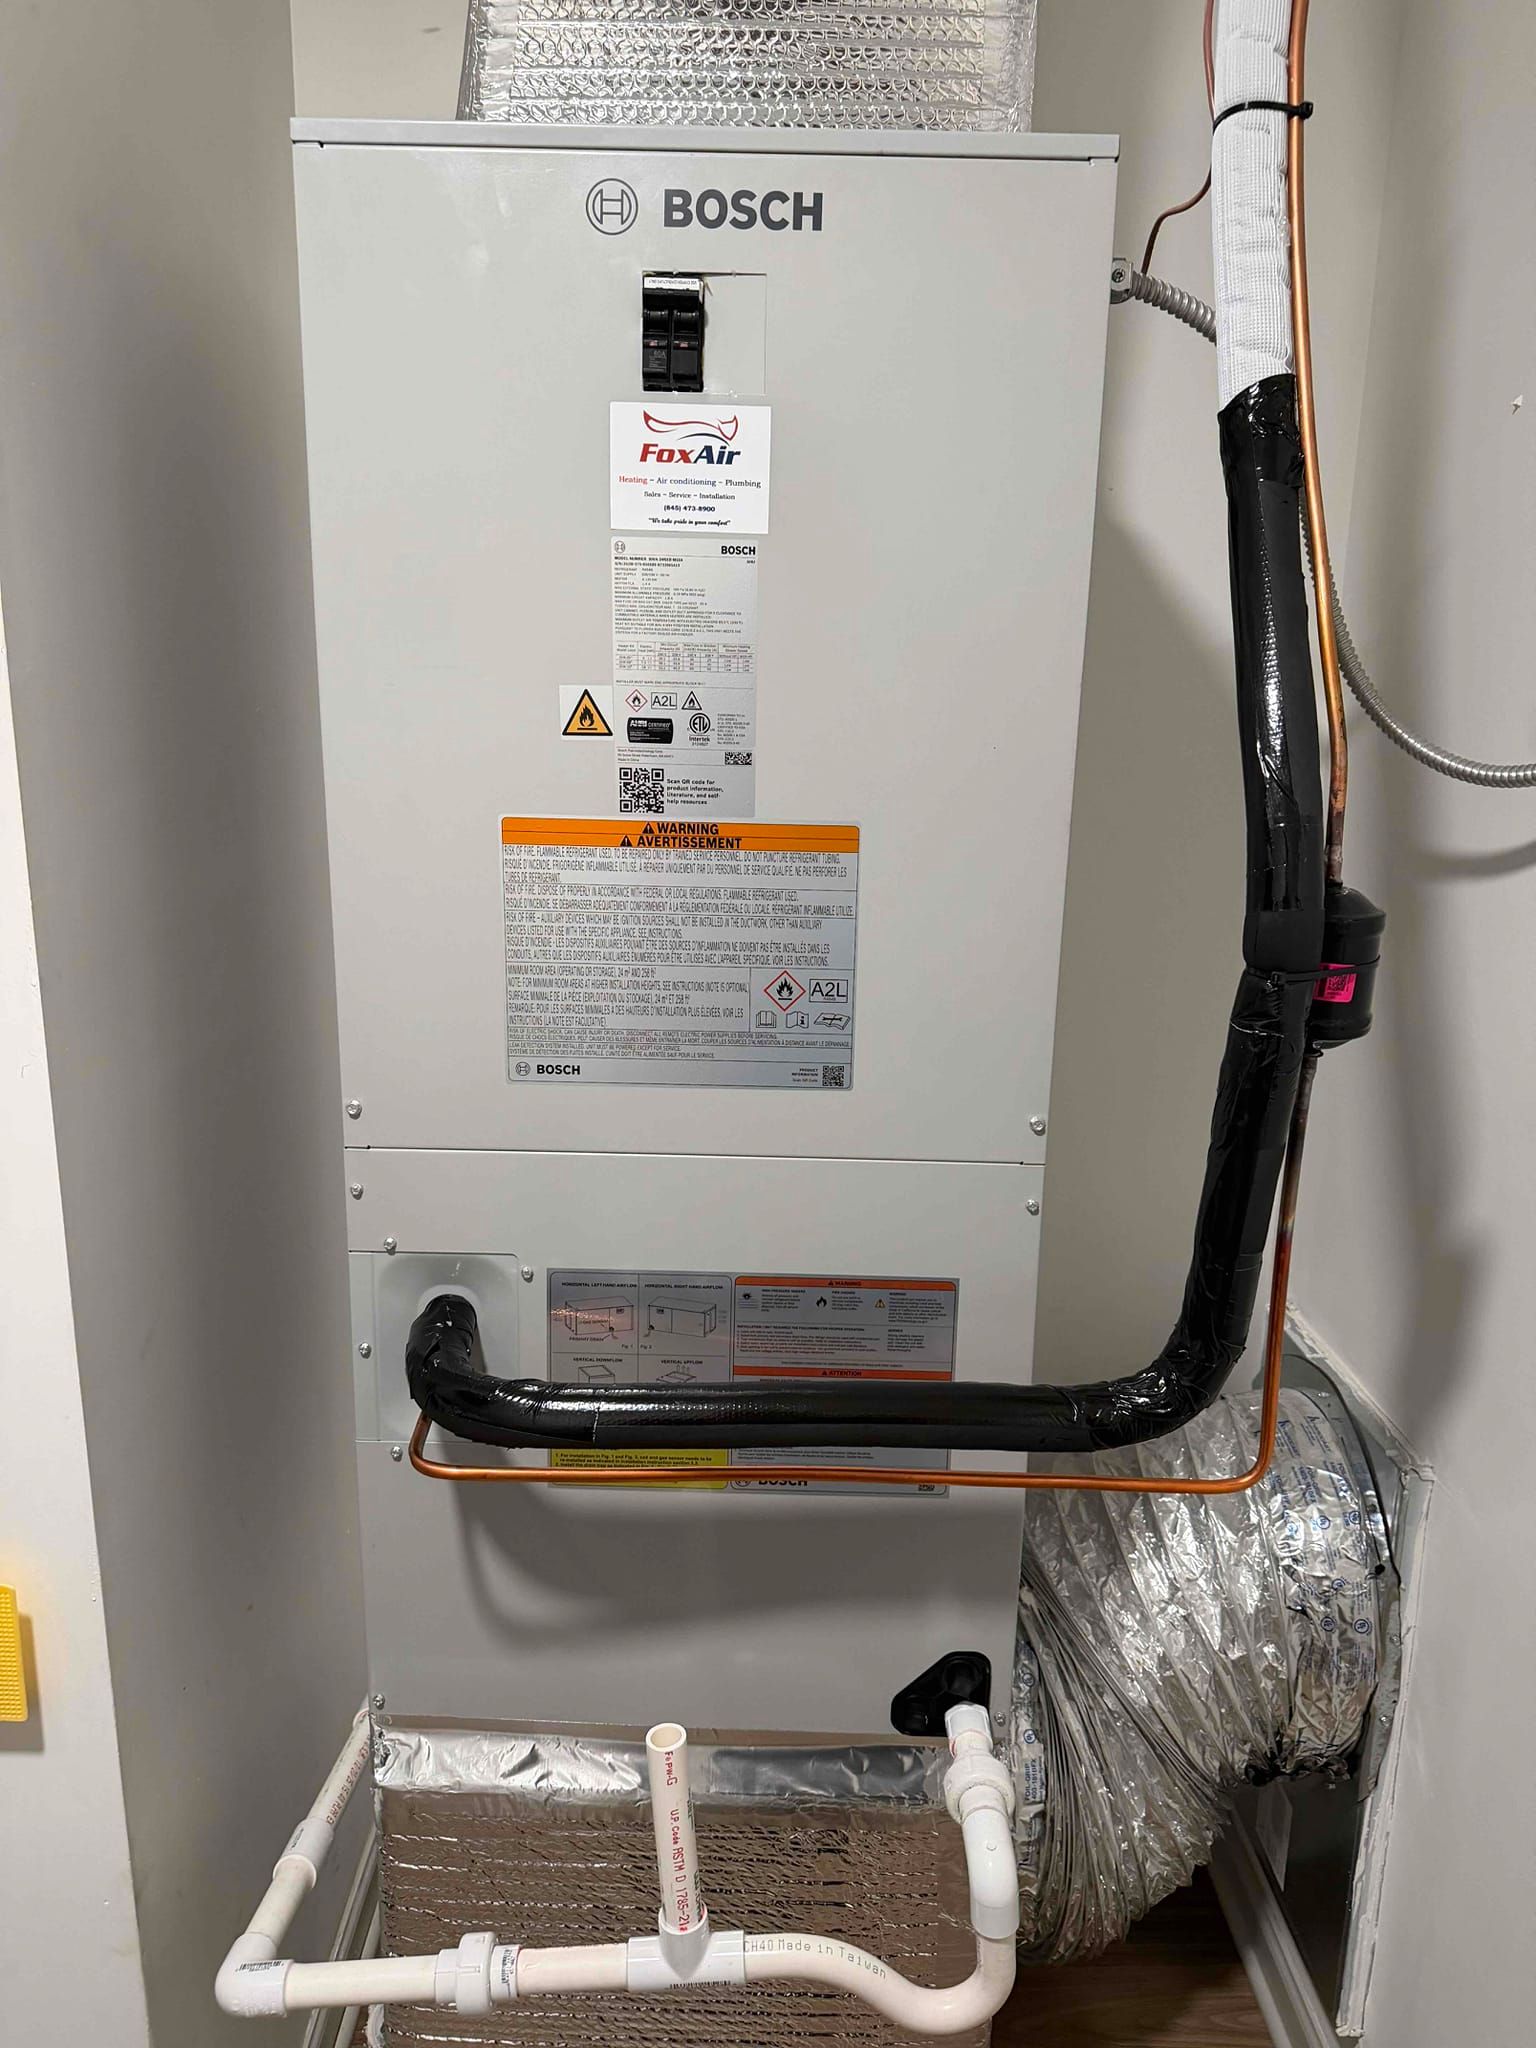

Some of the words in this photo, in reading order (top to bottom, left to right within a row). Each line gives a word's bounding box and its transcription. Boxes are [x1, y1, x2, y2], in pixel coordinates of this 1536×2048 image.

[664, 188, 823, 231] BOSCH
[640, 443, 741, 464] FoxAir
[619, 476, 648, 485] Heating
[670, 478, 716, 487] conditioning
[725, 480, 761, 488] Plumbing
[721, 546, 756, 555] BOSCH
[652, 696, 677, 706] A2L
[657, 823, 719, 835] WARNING
[637, 835, 742, 848] AVERTISSEMENT
[811, 982, 847, 997] A2L
[536, 1065, 581, 1075] BOSCH
[672, 1826, 680, 1845] Code
[673, 1847, 685, 1871] ASTM
[778, 1939, 811, 1951] Made
[818, 1944, 833, 1954] in
[839, 1946, 886, 1979] Taiwan
